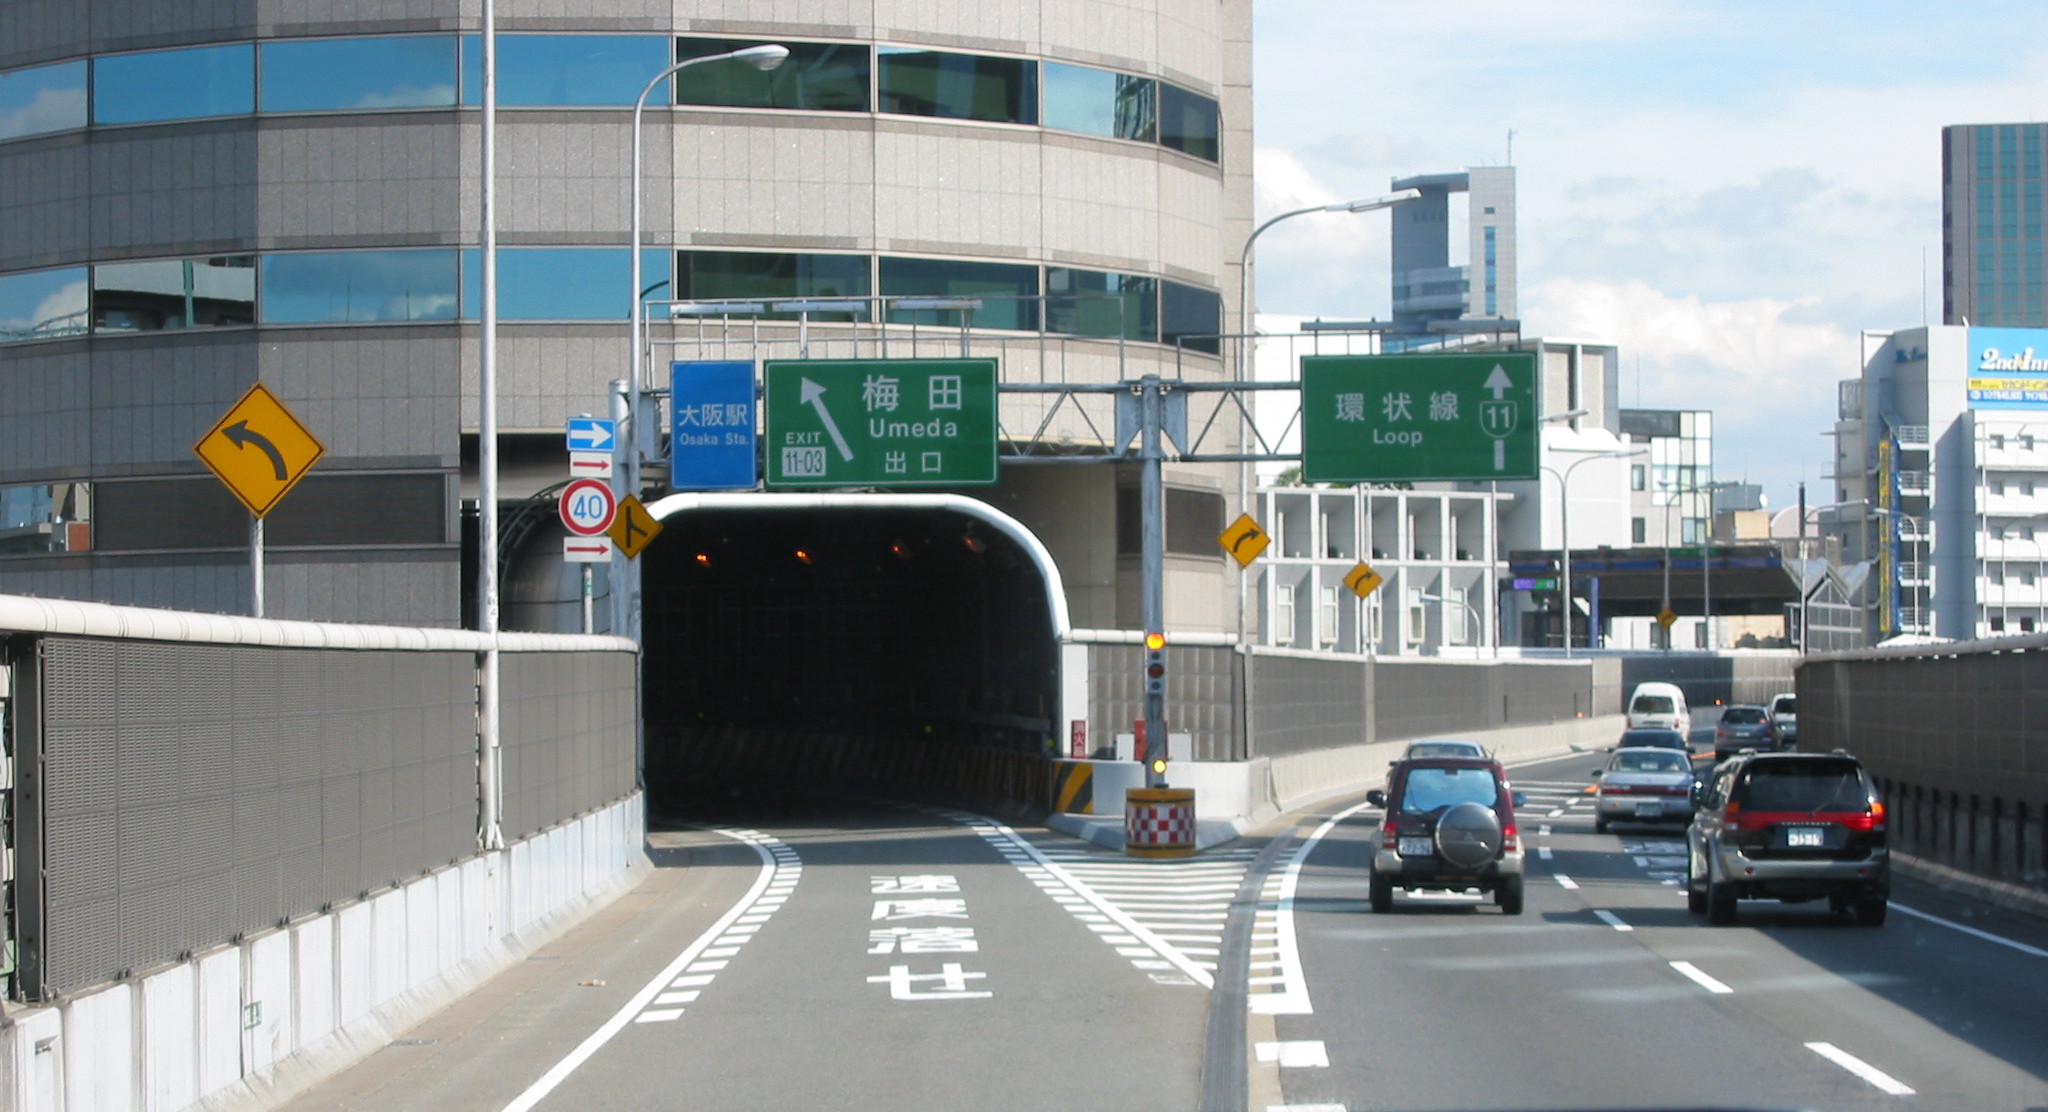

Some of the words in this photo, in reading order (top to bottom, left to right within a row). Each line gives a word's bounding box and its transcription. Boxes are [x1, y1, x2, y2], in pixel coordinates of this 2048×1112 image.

[862, 374, 961, 412] 梅田
[679, 404, 747, 426] 大阪駅
[1335, 392, 1459, 421] 環状線
[1487, 406, 1510, 429] 11
[680, 432, 718, 445] Osaka
[726, 432, 749, 445] Sta.
[786, 432, 821, 445] EXIT
[870, 418, 957, 438] Umeda
[1373, 429, 1423, 446] Loop
[786, 451, 823, 473] 11-03
[885, 451, 941, 473] 出口
[573, 495, 603, 519] 40
